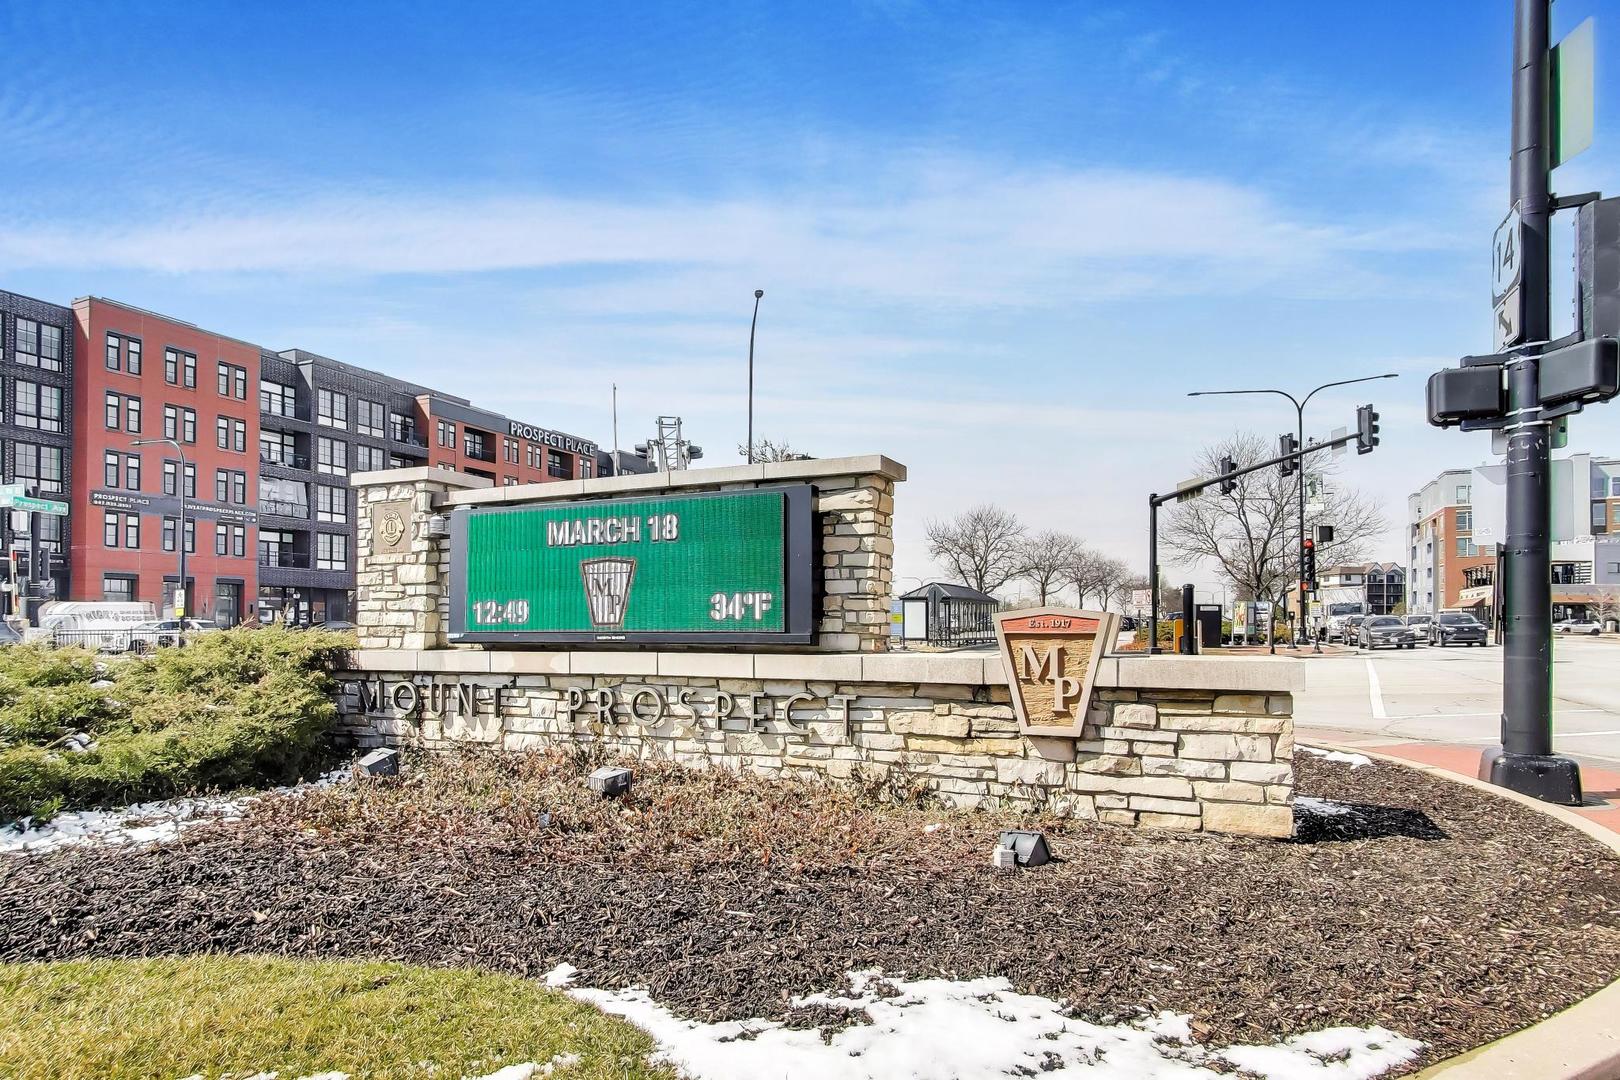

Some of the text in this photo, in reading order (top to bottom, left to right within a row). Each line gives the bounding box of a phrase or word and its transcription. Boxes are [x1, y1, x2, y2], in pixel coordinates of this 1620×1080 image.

[1497, 228, 1514, 283] 14
[510, 421, 595, 456] PROSPECT PLACE
[547, 514, 679, 547] MARCH 18
[472, 600, 530, 624] 12:49
[1028, 619, 1072, 629] Est. 1917
[357, 680, 858, 738] MOUNT PROSPECT
